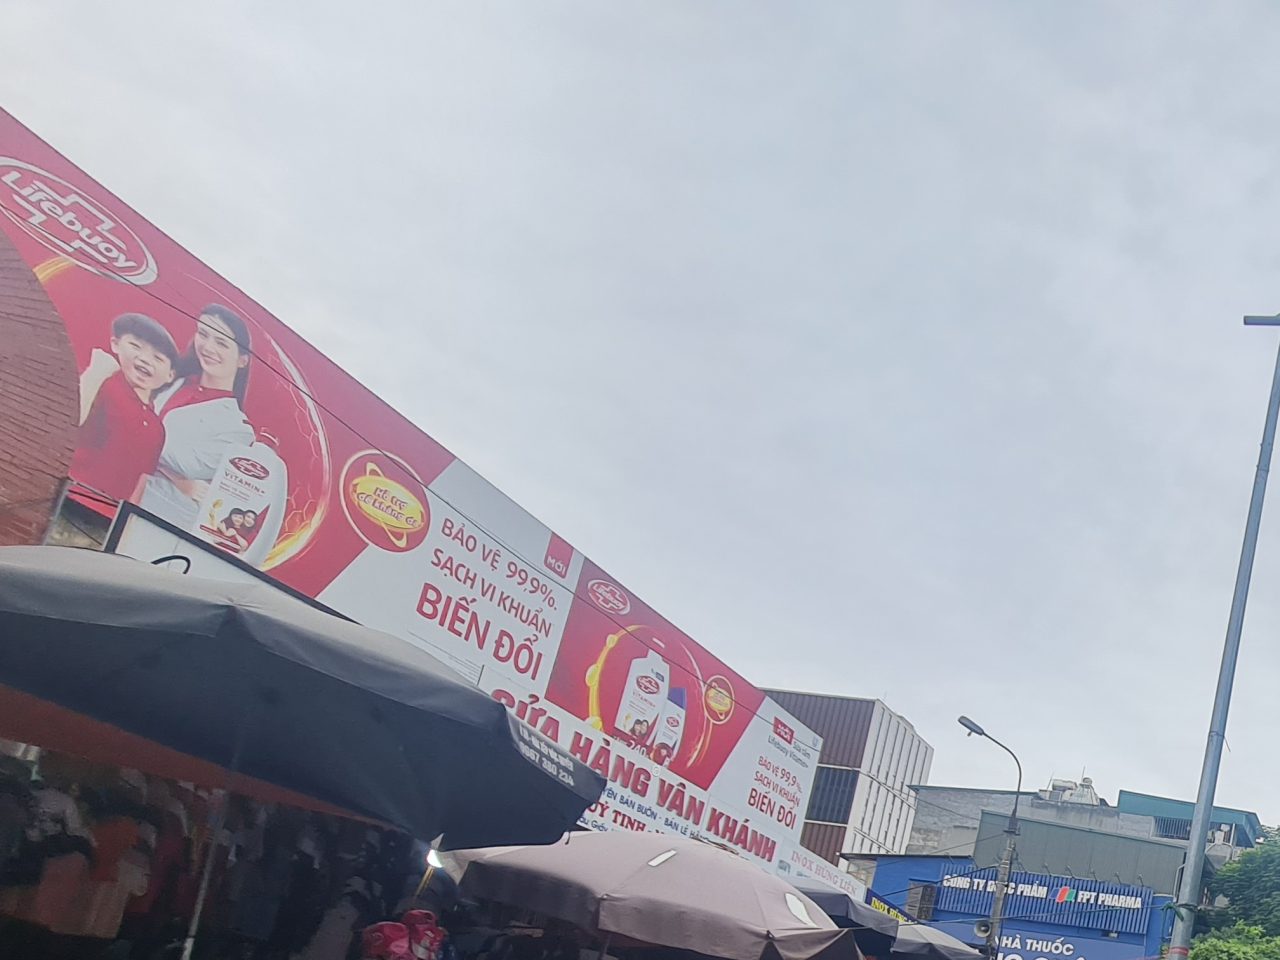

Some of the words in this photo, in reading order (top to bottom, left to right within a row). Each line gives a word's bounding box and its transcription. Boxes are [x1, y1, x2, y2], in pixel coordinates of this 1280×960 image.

[1, 171, 137, 268] Lifebuoy
[441, 518, 477, 552] BẢO
[482, 544, 501, 571] VỆ
[546, 556, 567, 575] MỚI
[431, 548, 477, 589] SẠCH
[481, 578, 497, 602] VI
[498, 591, 552, 638] KHUẨN
[416, 583, 491, 650] BIẾN
[493, 629, 543, 680] ĐỔI
[569, 731, 652, 798] HÀNG
[656, 778, 705, 826] VÂN
[706, 807, 776, 863] KHÁNH
[748, 788, 776, 817] BIẾN
[612, 810, 645, 832] TINH
[791, 850, 814, 871] INOX
[943, 874, 970, 889] CÔNG
[973, 878, 985, 890] TY
[1077, 890, 1097, 904] FPT
[1097, 892, 1142, 909] PHARMA
[1025, 937, 1074, 956] THUỐC
